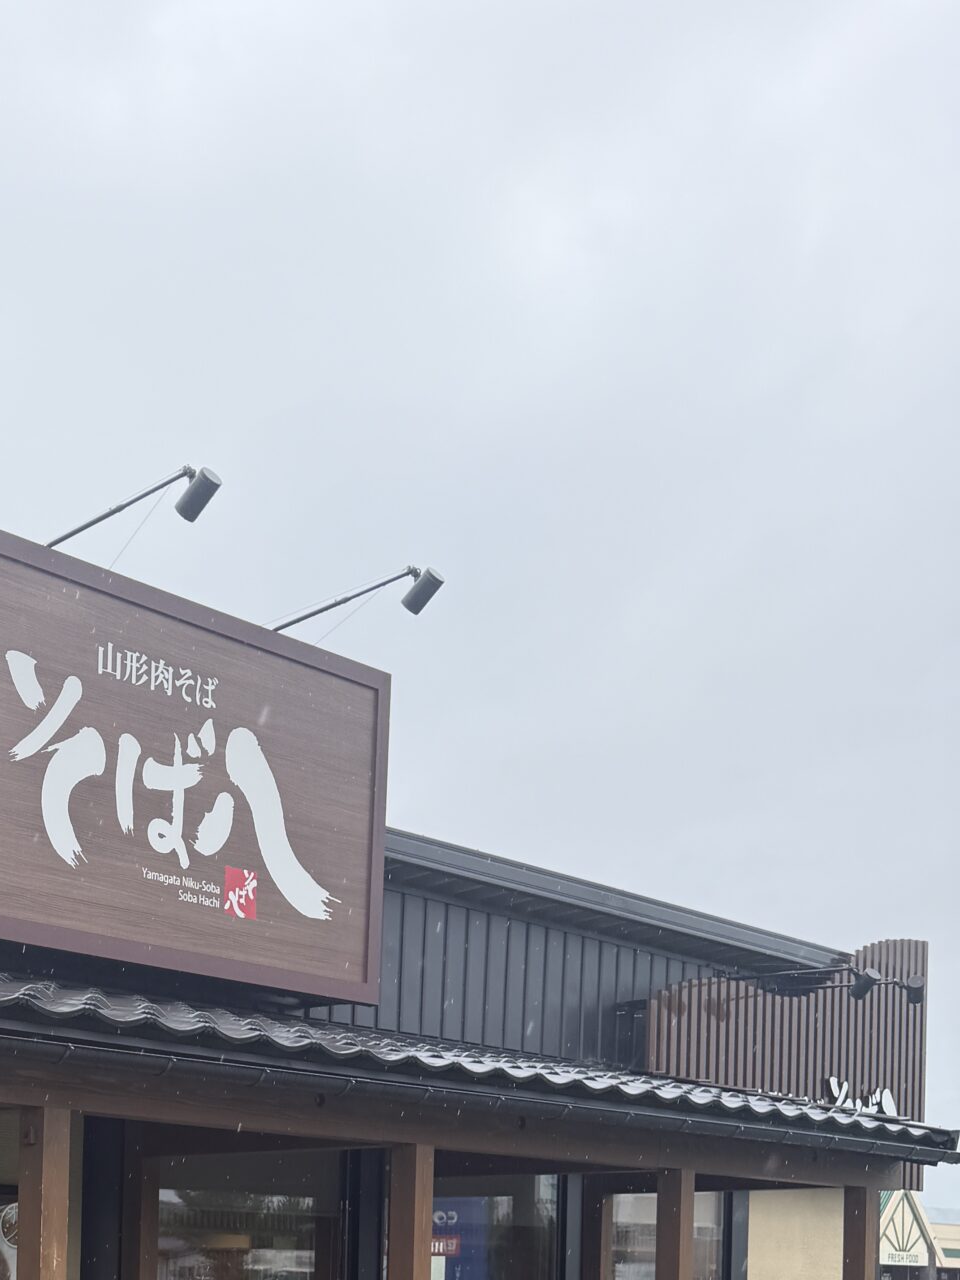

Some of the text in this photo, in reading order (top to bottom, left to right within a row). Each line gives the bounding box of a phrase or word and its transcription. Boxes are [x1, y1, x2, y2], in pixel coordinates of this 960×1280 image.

[96, 641, 219, 709] 山形肉そば
[5, 650, 341, 920] そば八
[141, 867, 220, 894] Yamagata Niku-Soba
[178, 890, 220, 909] Soba Hachi
[887, 1252, 919, 1264] FRESH FOOD
